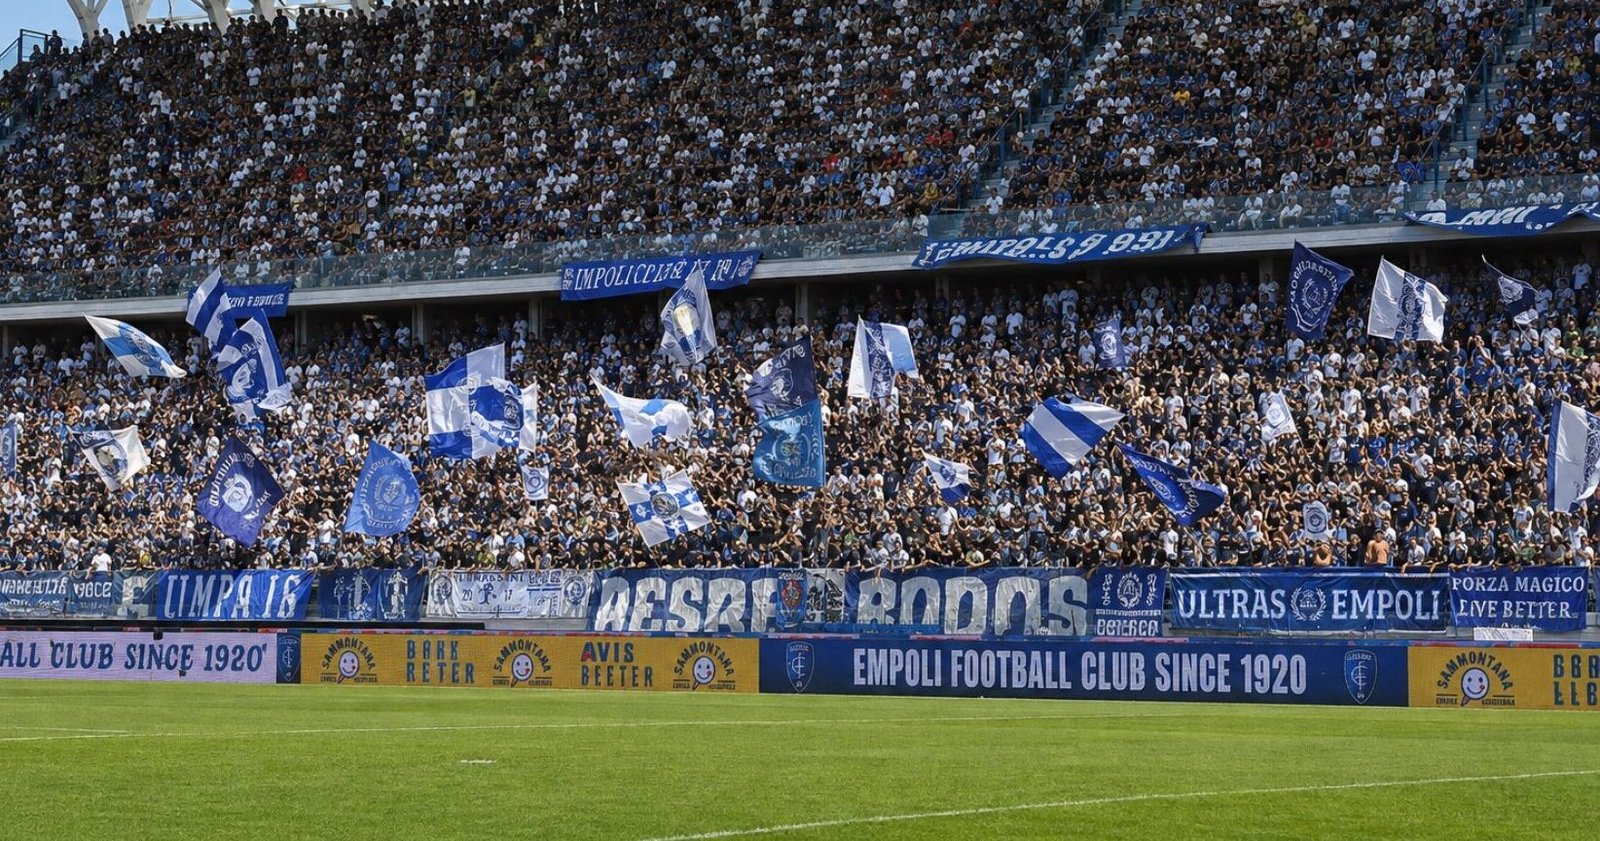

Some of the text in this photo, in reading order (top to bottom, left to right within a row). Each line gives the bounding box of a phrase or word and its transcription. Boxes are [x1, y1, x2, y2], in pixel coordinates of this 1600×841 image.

[1515, 576, 1585, 593] MAGICO
[1177, 589, 1286, 619] ULTRAS
[1331, 589, 1441, 621] EMPOLI
[51, 642, 114, 669] CLUB
[124, 643, 194, 671] SINCE
[494, 639, 551, 673] SAMMONTANA
[581, 642, 634, 663] AVIS
[674, 641, 734, 677] SAMMONTANA
[581, 665, 653, 688] BEETER
[853, 648, 1307, 695] EMPOLI FOOTBALL CLUB SINCE 1920
[1437, 651, 1514, 691] SAMMONTANA
